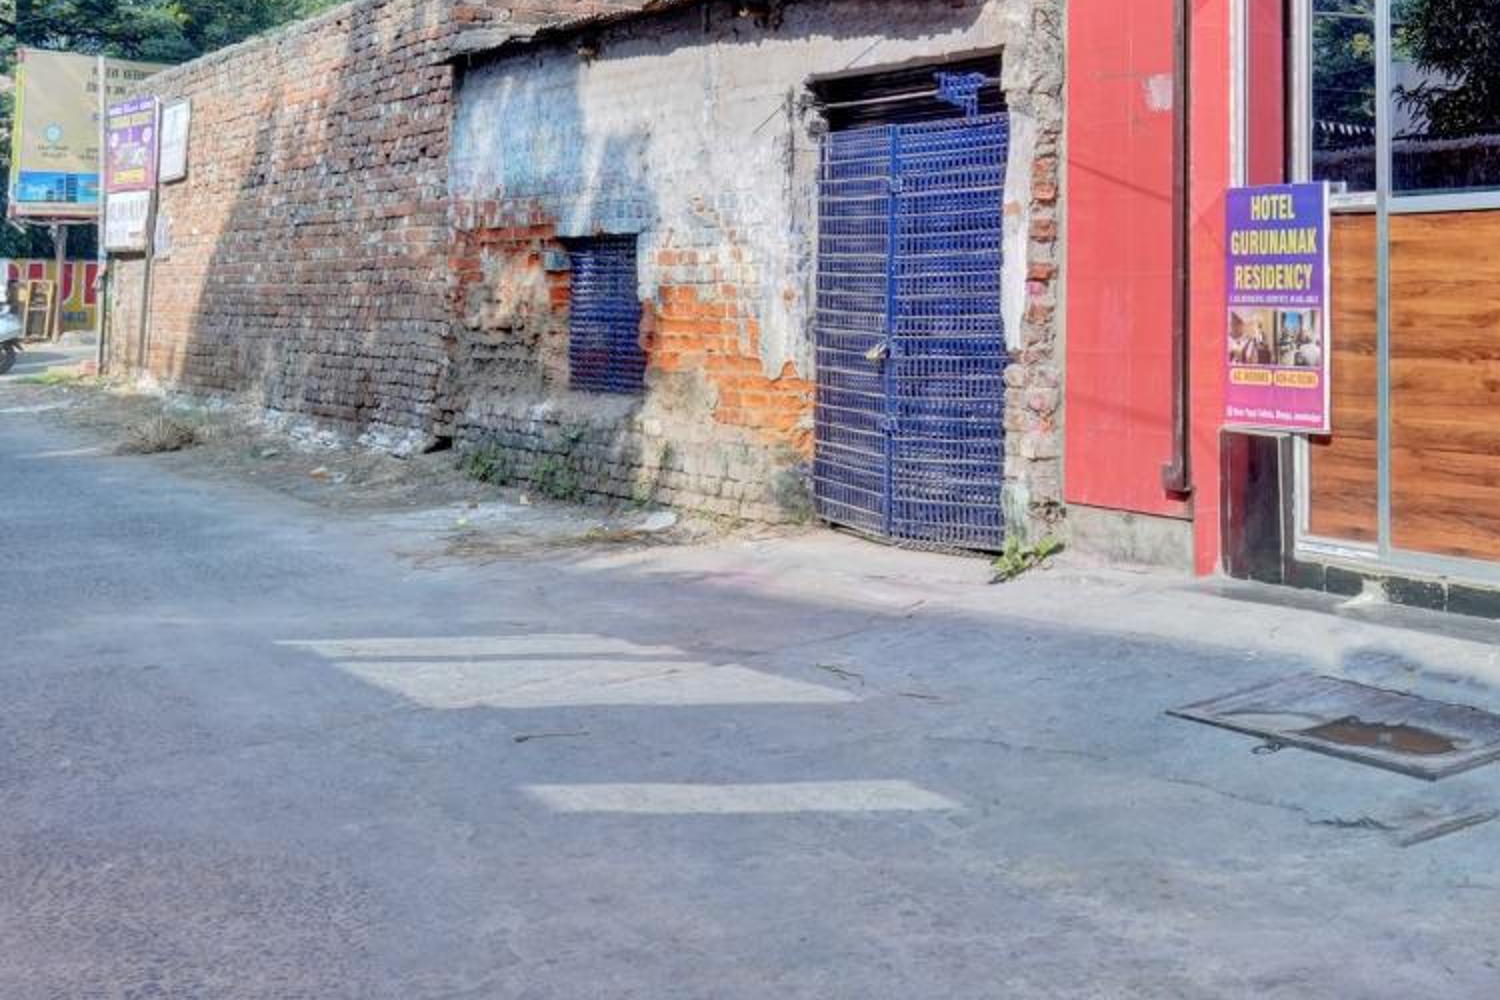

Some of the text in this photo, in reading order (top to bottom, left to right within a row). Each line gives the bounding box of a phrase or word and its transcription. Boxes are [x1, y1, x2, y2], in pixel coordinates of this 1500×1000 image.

[1251, 193, 1295, 221] HOTEL
[1231, 228, 1317, 255] GURUNANAK
[1234, 263, 1313, 291] RESIDENCY
